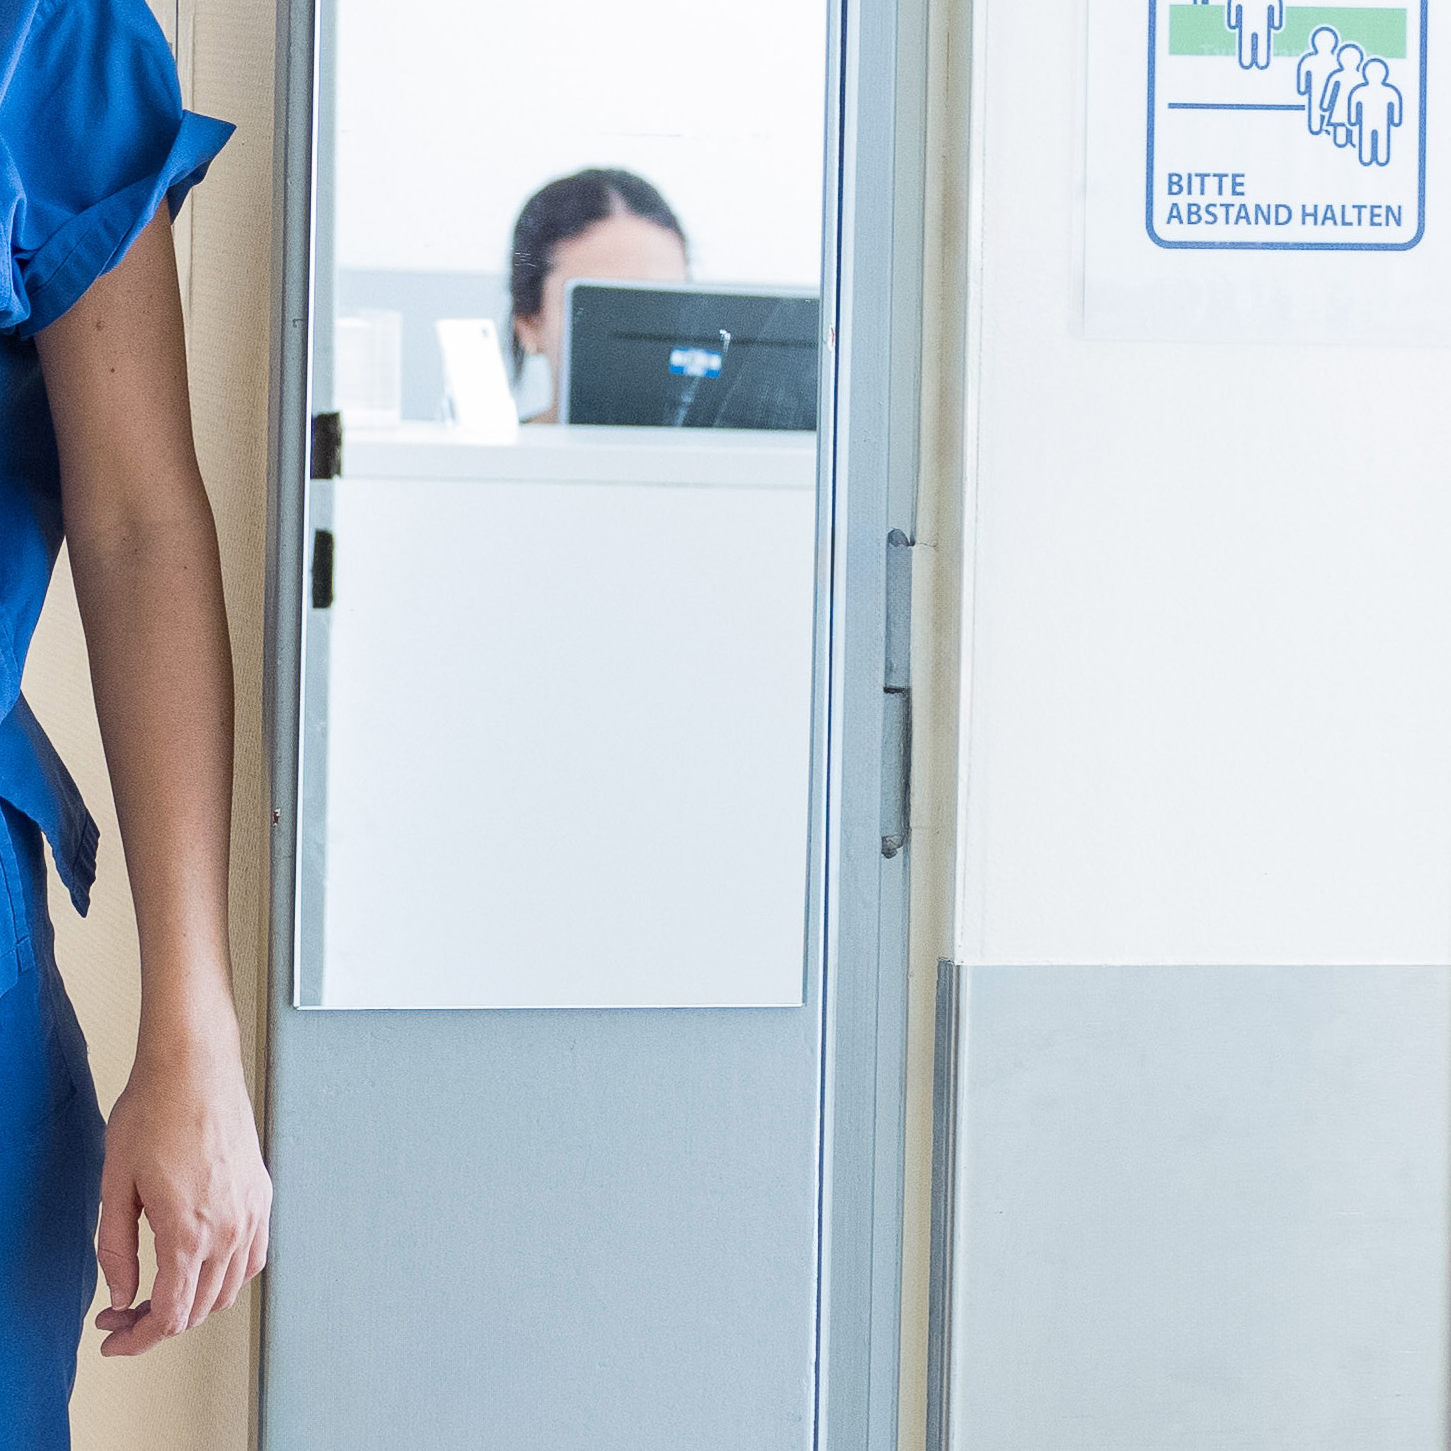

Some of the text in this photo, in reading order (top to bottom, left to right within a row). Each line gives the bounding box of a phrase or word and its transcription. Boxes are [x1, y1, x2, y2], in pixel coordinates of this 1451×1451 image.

[1167, 172, 1246, 197] BITTE
[1166, 202, 1402, 227] ABSTAND HALTEN
